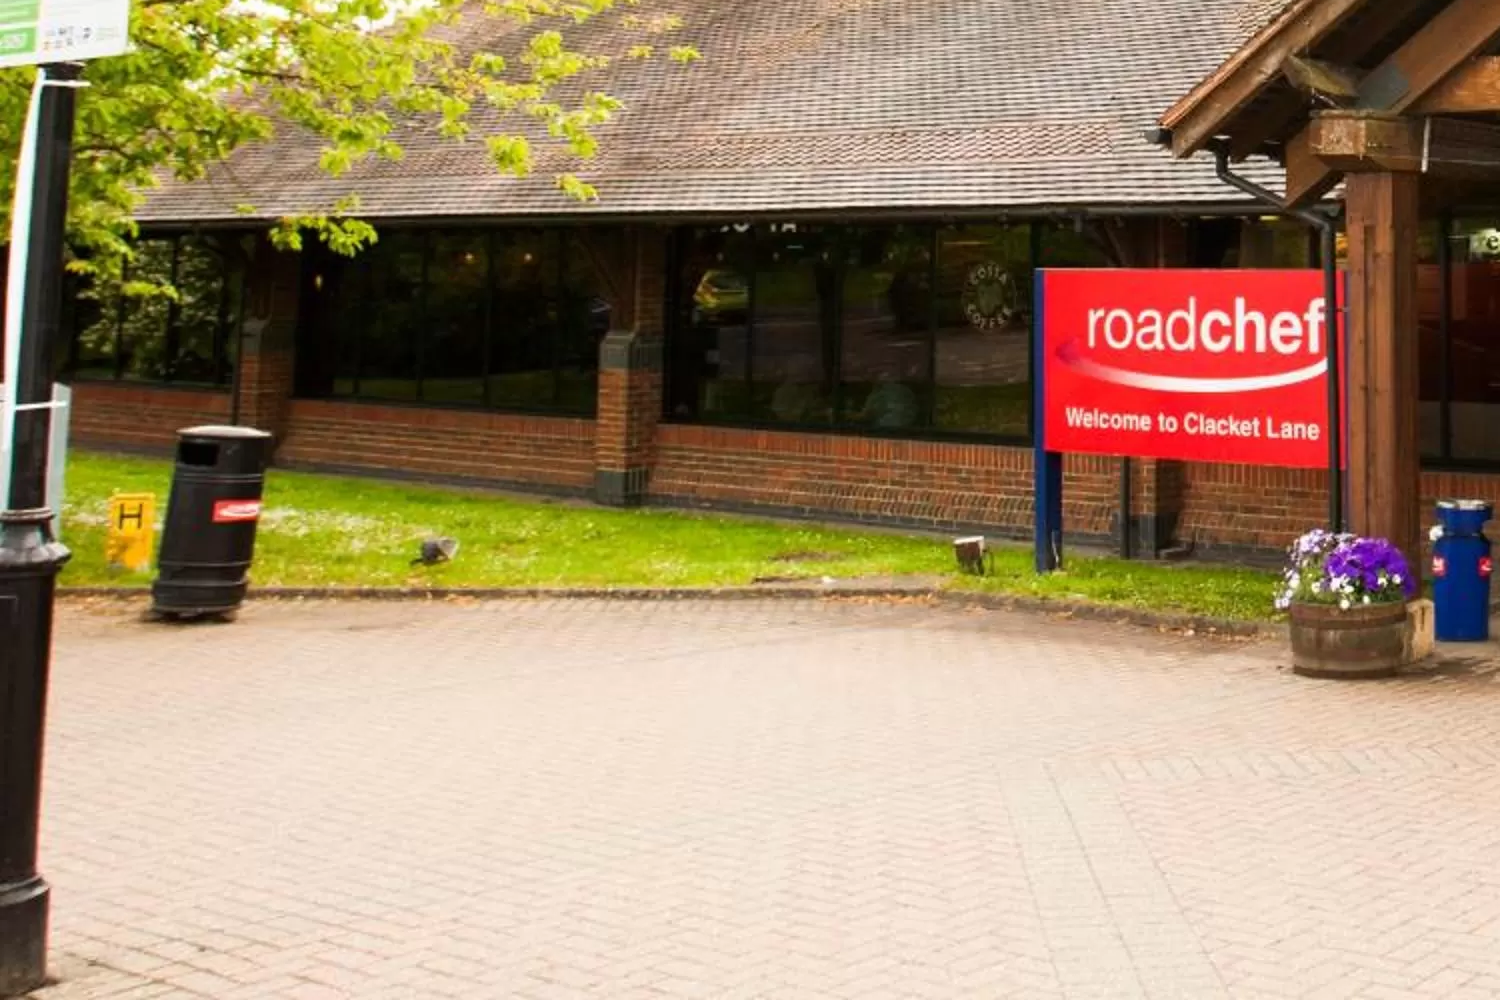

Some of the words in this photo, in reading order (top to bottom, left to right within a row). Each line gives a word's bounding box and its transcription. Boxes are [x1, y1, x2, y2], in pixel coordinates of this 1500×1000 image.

[1087, 296, 1325, 354] roadchef
[1065, 407, 1152, 432] Welcome
[1158, 412, 1178, 433] to
[1183, 411, 1261, 437] Clacket
[1266, 416, 1321, 440] Lane
[119, 503, 143, 530] H
